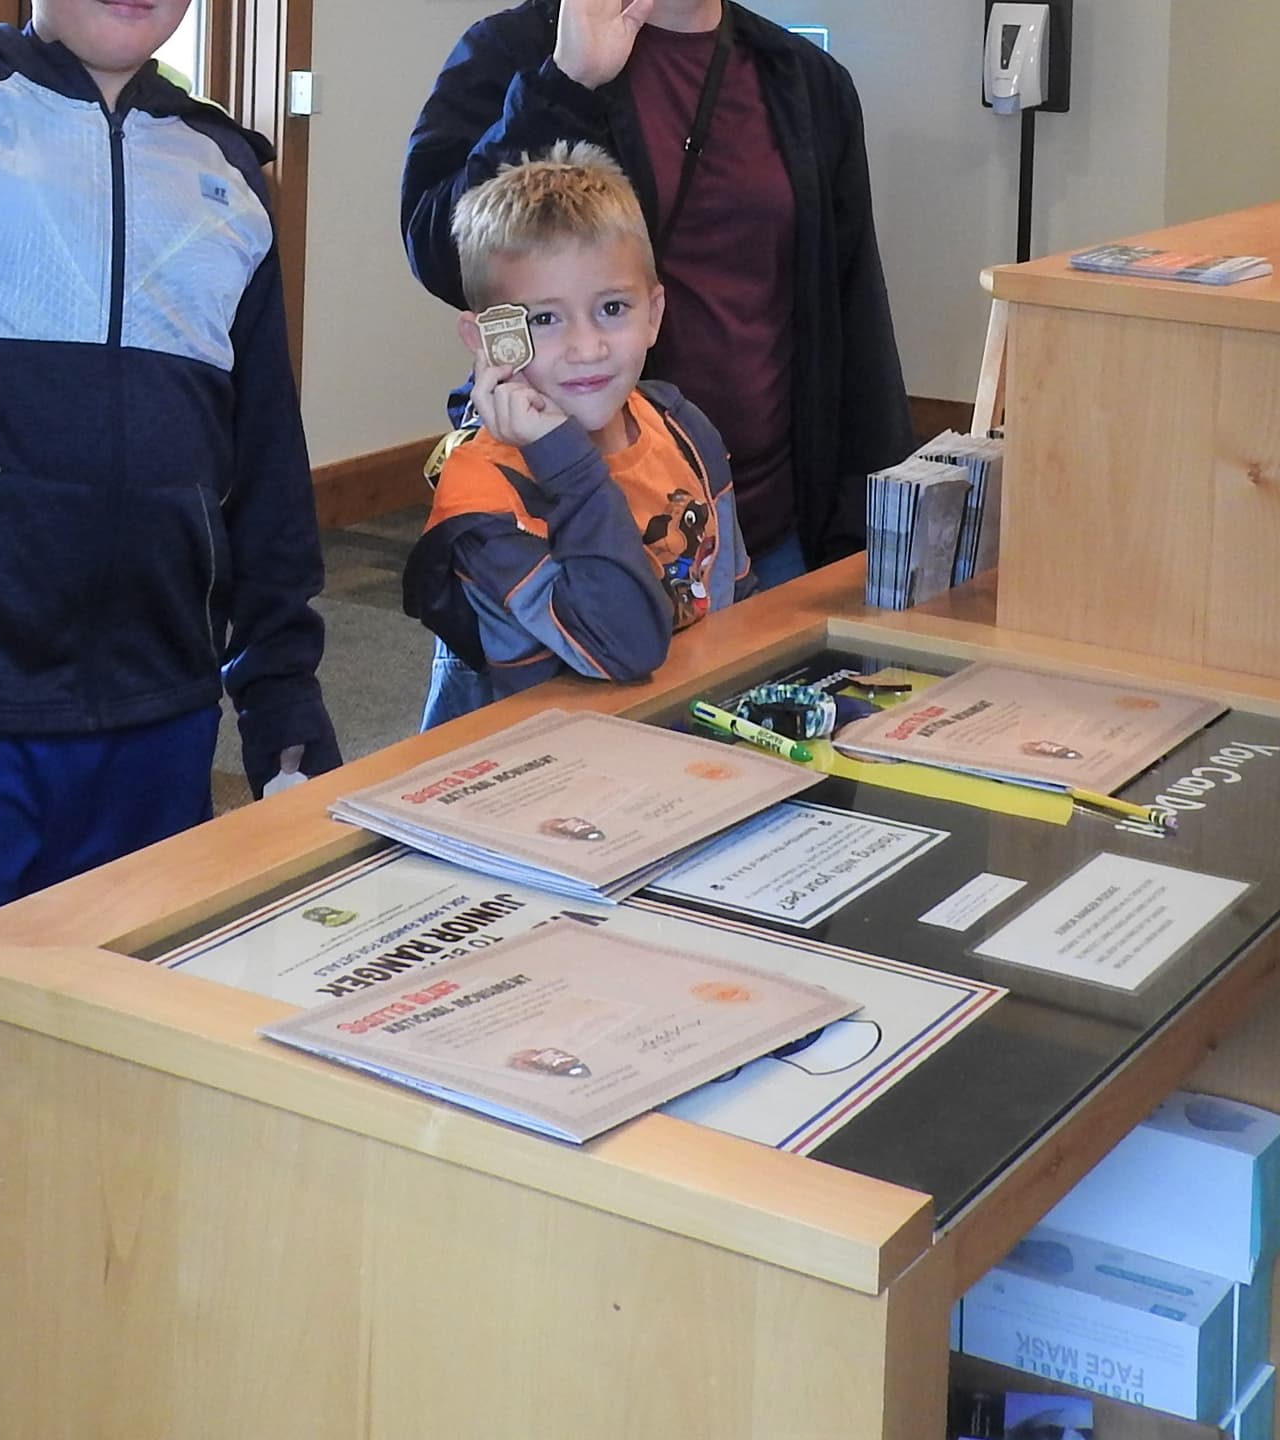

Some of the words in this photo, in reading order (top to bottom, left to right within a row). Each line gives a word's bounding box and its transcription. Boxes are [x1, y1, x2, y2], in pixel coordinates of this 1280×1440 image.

[1210, 741, 1280, 767] You
[1166, 766, 1242, 796] Can
[430, 893, 528, 943] JUNIOR
[468, 934, 505, 949] TO
[316, 931, 446, 998] RANGER
[381, 1005, 456, 1034] NATIONAL
[1016, 1331, 1078, 1369] MASK
[1016, 1354, 1144, 1405] DISPOSABLE
[1086, 1352, 1144, 1389] FACE
